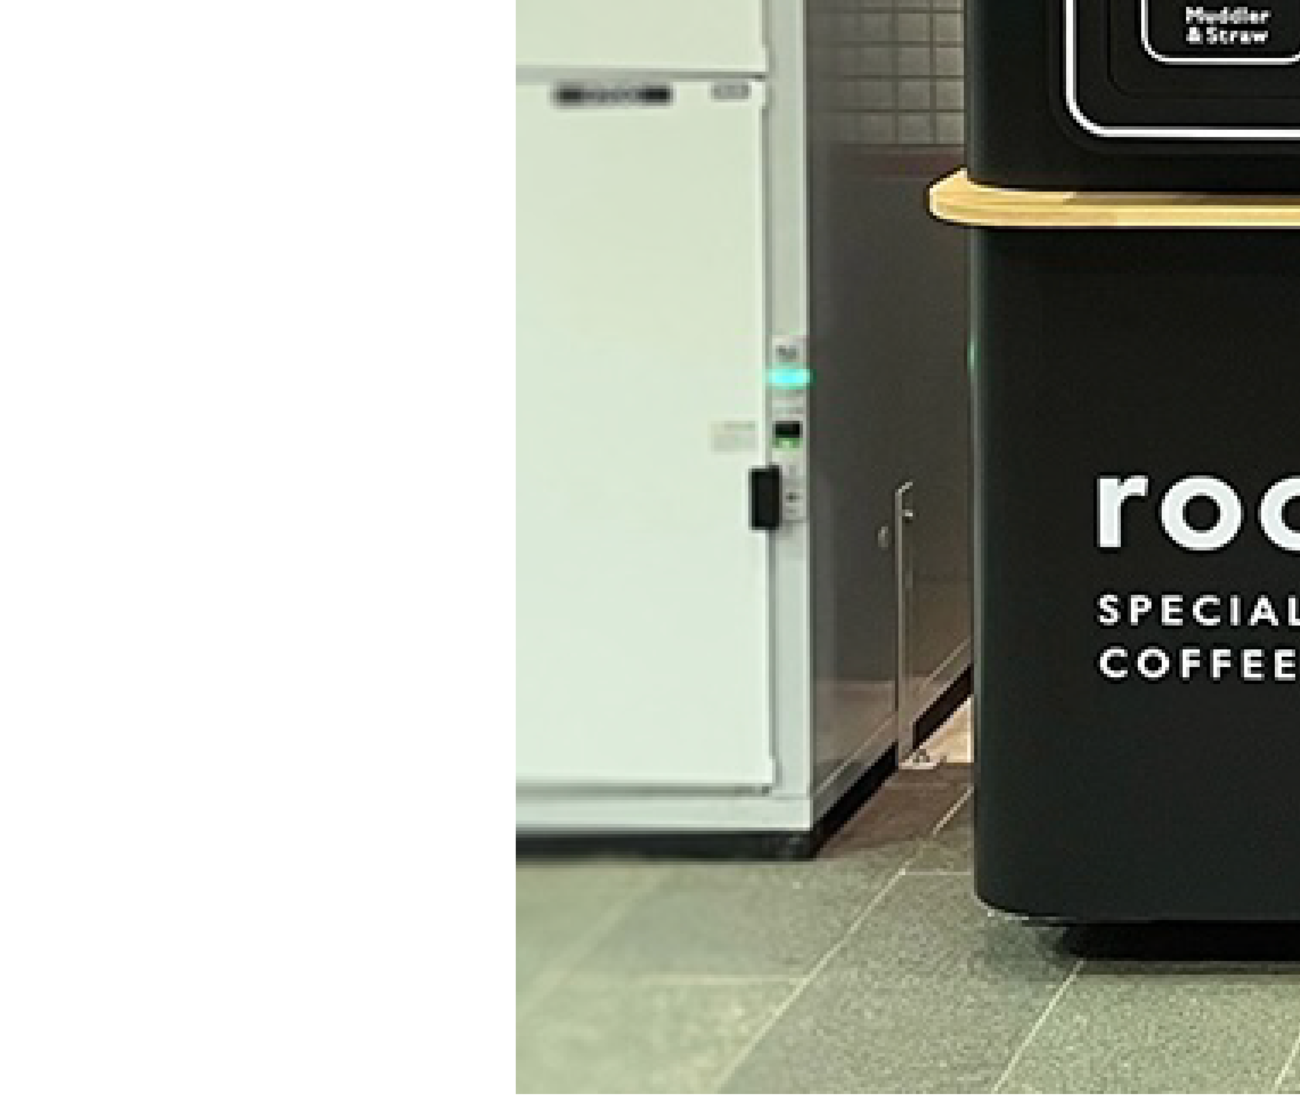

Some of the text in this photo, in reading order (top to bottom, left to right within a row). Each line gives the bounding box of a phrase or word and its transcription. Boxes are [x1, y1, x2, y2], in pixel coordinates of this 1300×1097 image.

[1185, 6, 1272, 25] Muddler
[1186, 27, 1269, 45] & Straw
[1099, 646, 1296, 681] COFFEE
